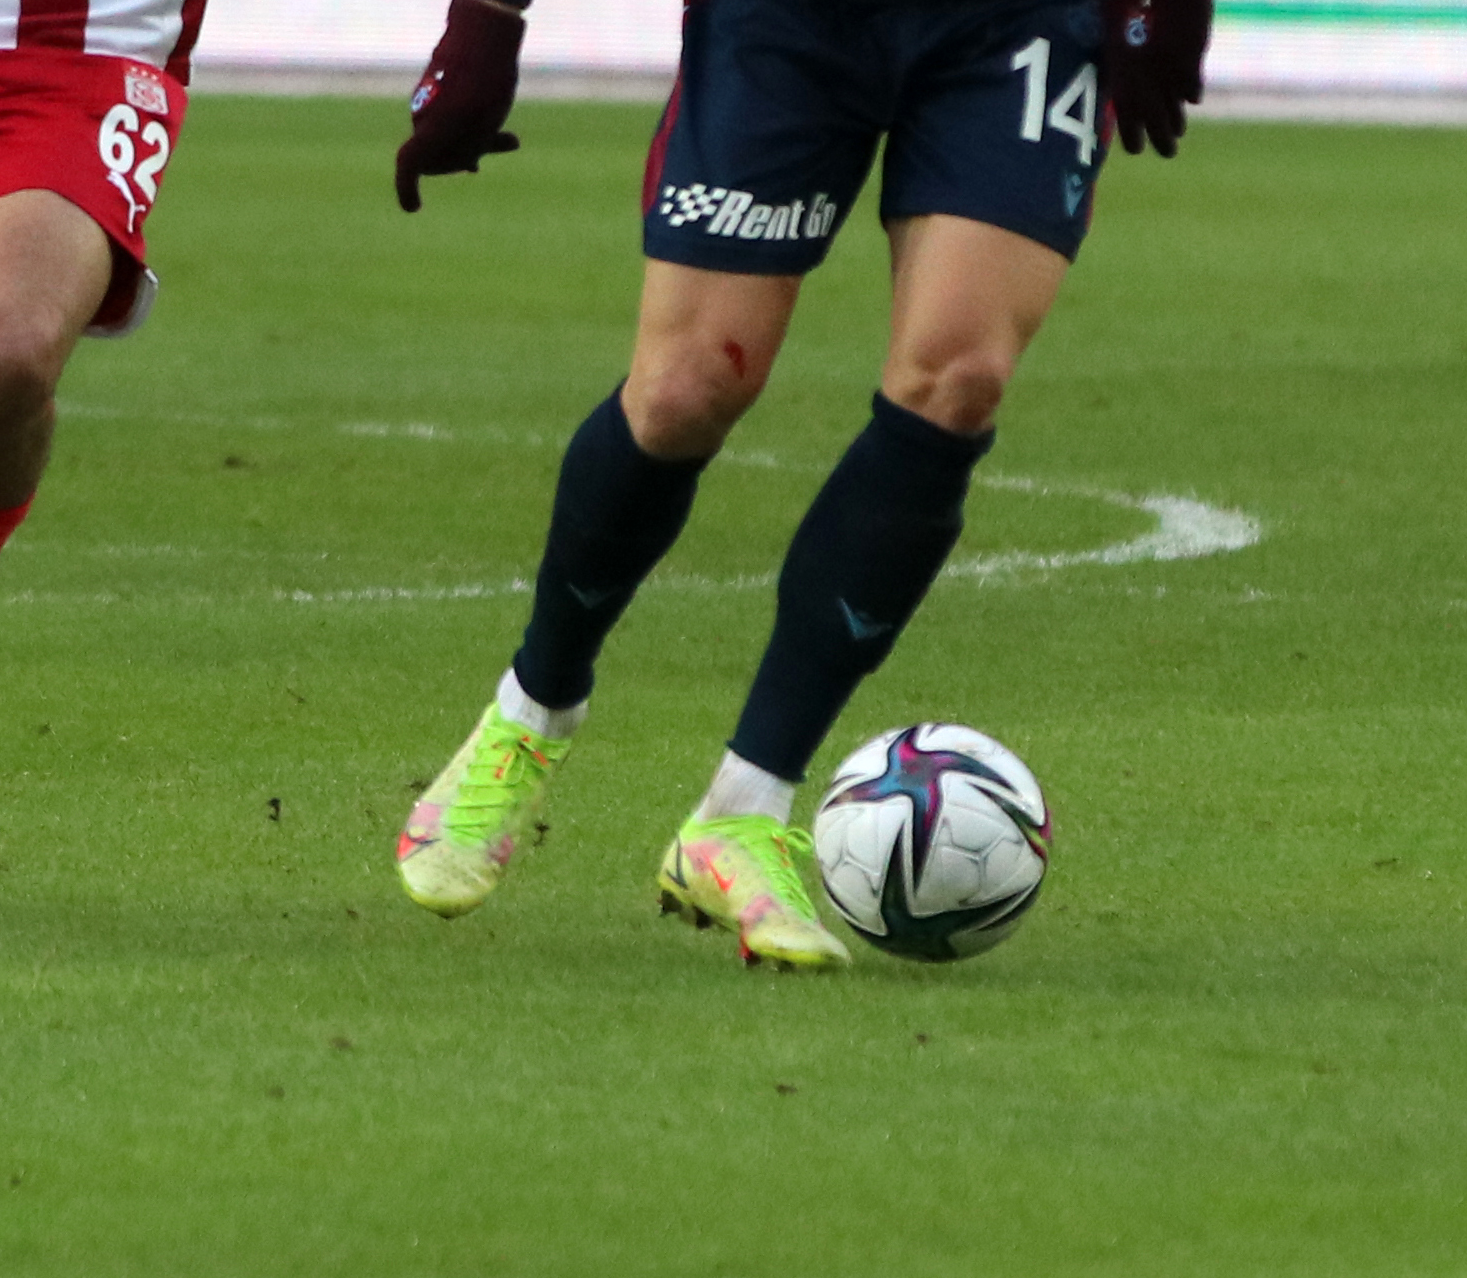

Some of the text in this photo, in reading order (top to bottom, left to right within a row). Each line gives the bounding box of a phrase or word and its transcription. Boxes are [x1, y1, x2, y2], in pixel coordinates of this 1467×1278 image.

[1010, 36, 1098, 166] 14
[98, 103, 170, 204] 62
[704, 189, 806, 241] Rent
